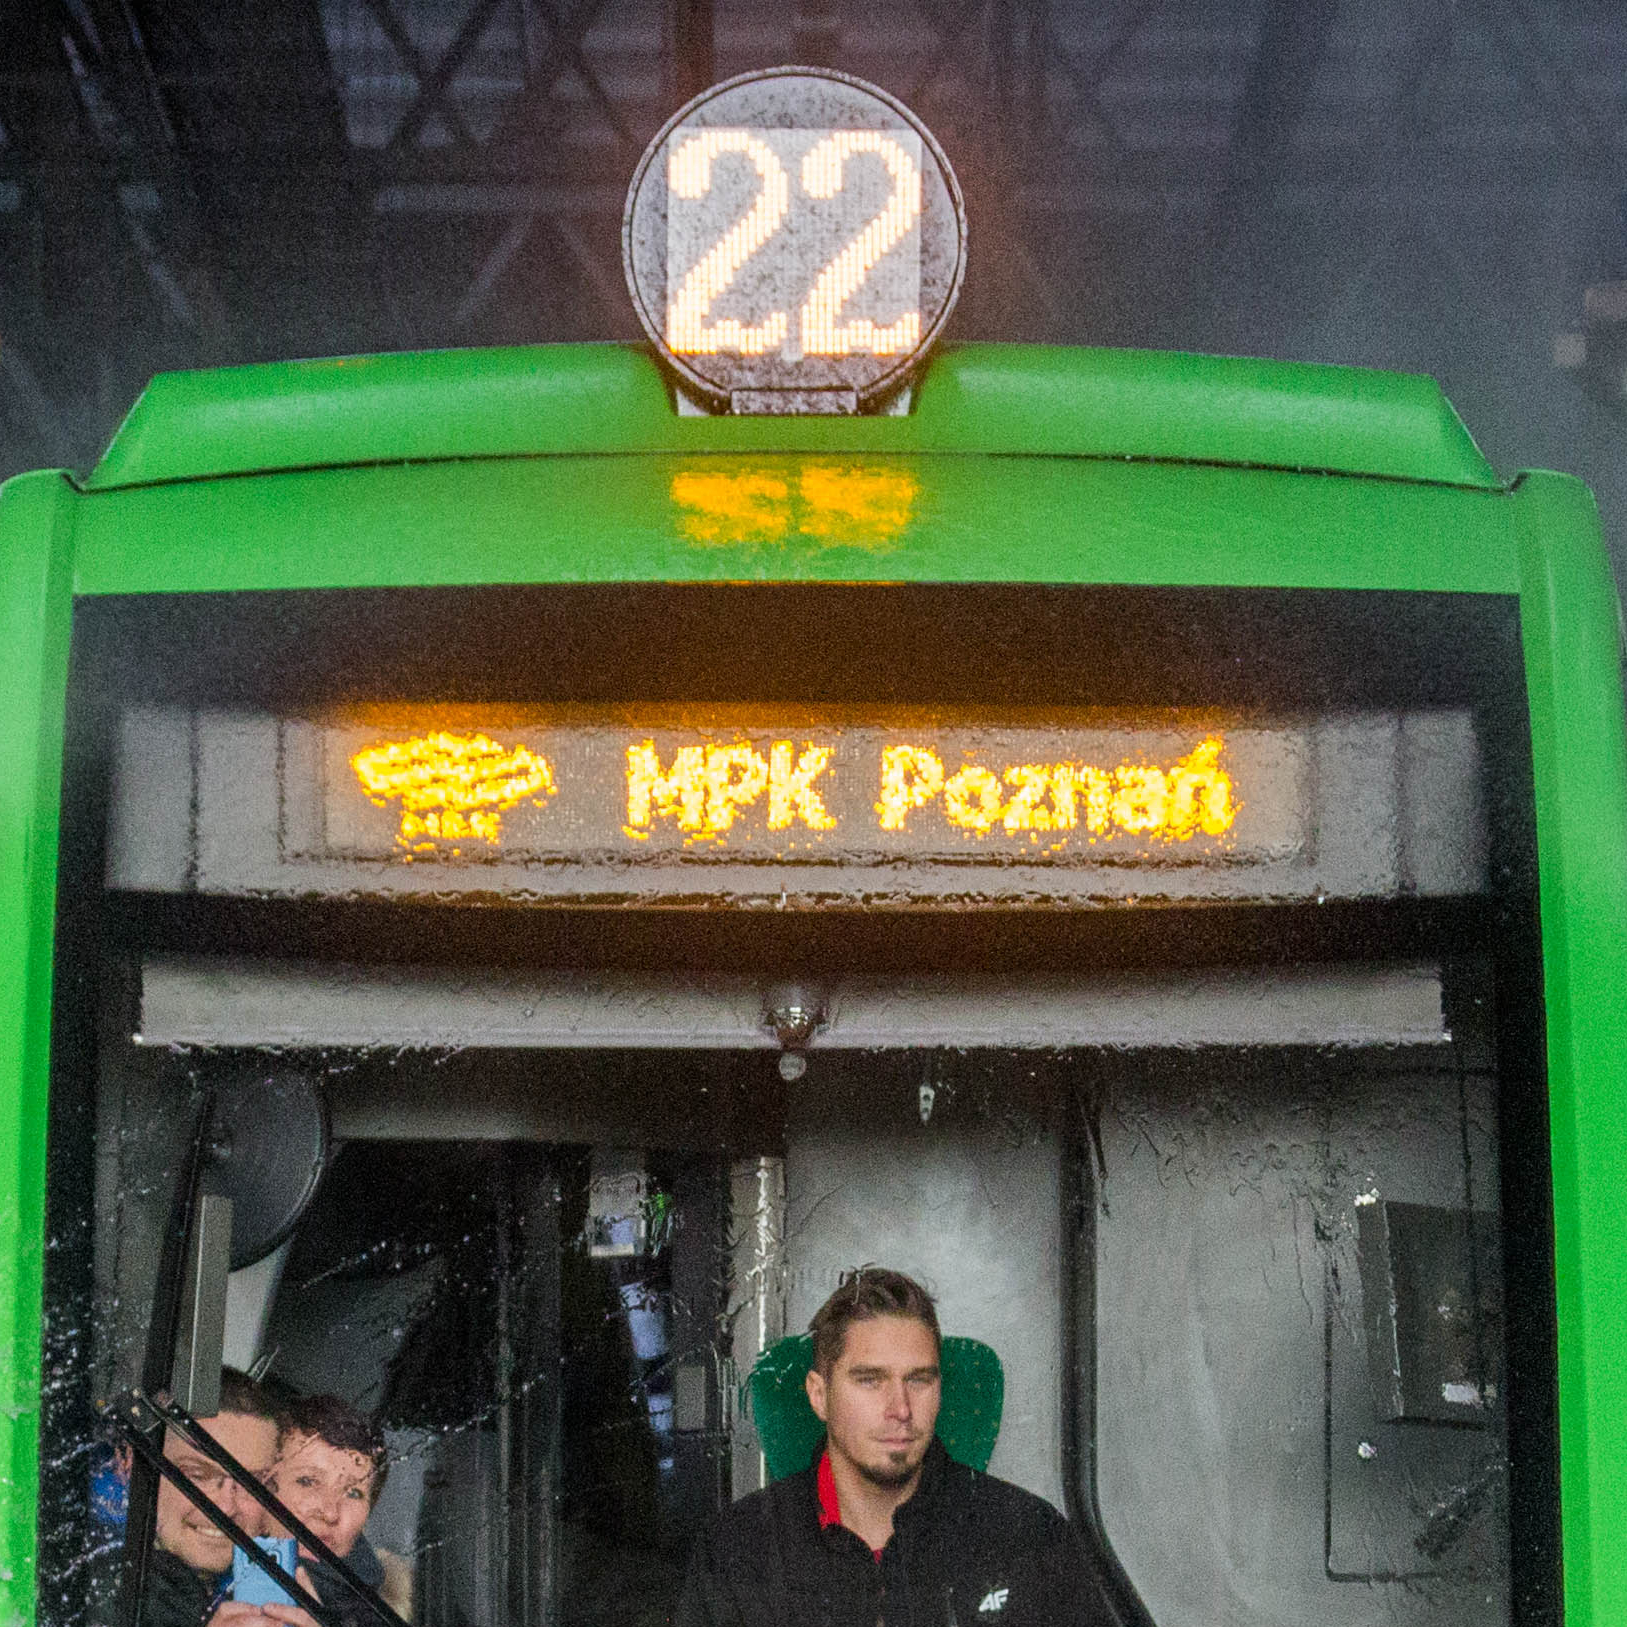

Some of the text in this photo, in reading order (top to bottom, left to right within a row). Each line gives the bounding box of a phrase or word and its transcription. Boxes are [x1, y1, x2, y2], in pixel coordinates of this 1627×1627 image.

[668, 131, 921, 355] 22
[624, 733, 1243, 837] MPK Poznań
